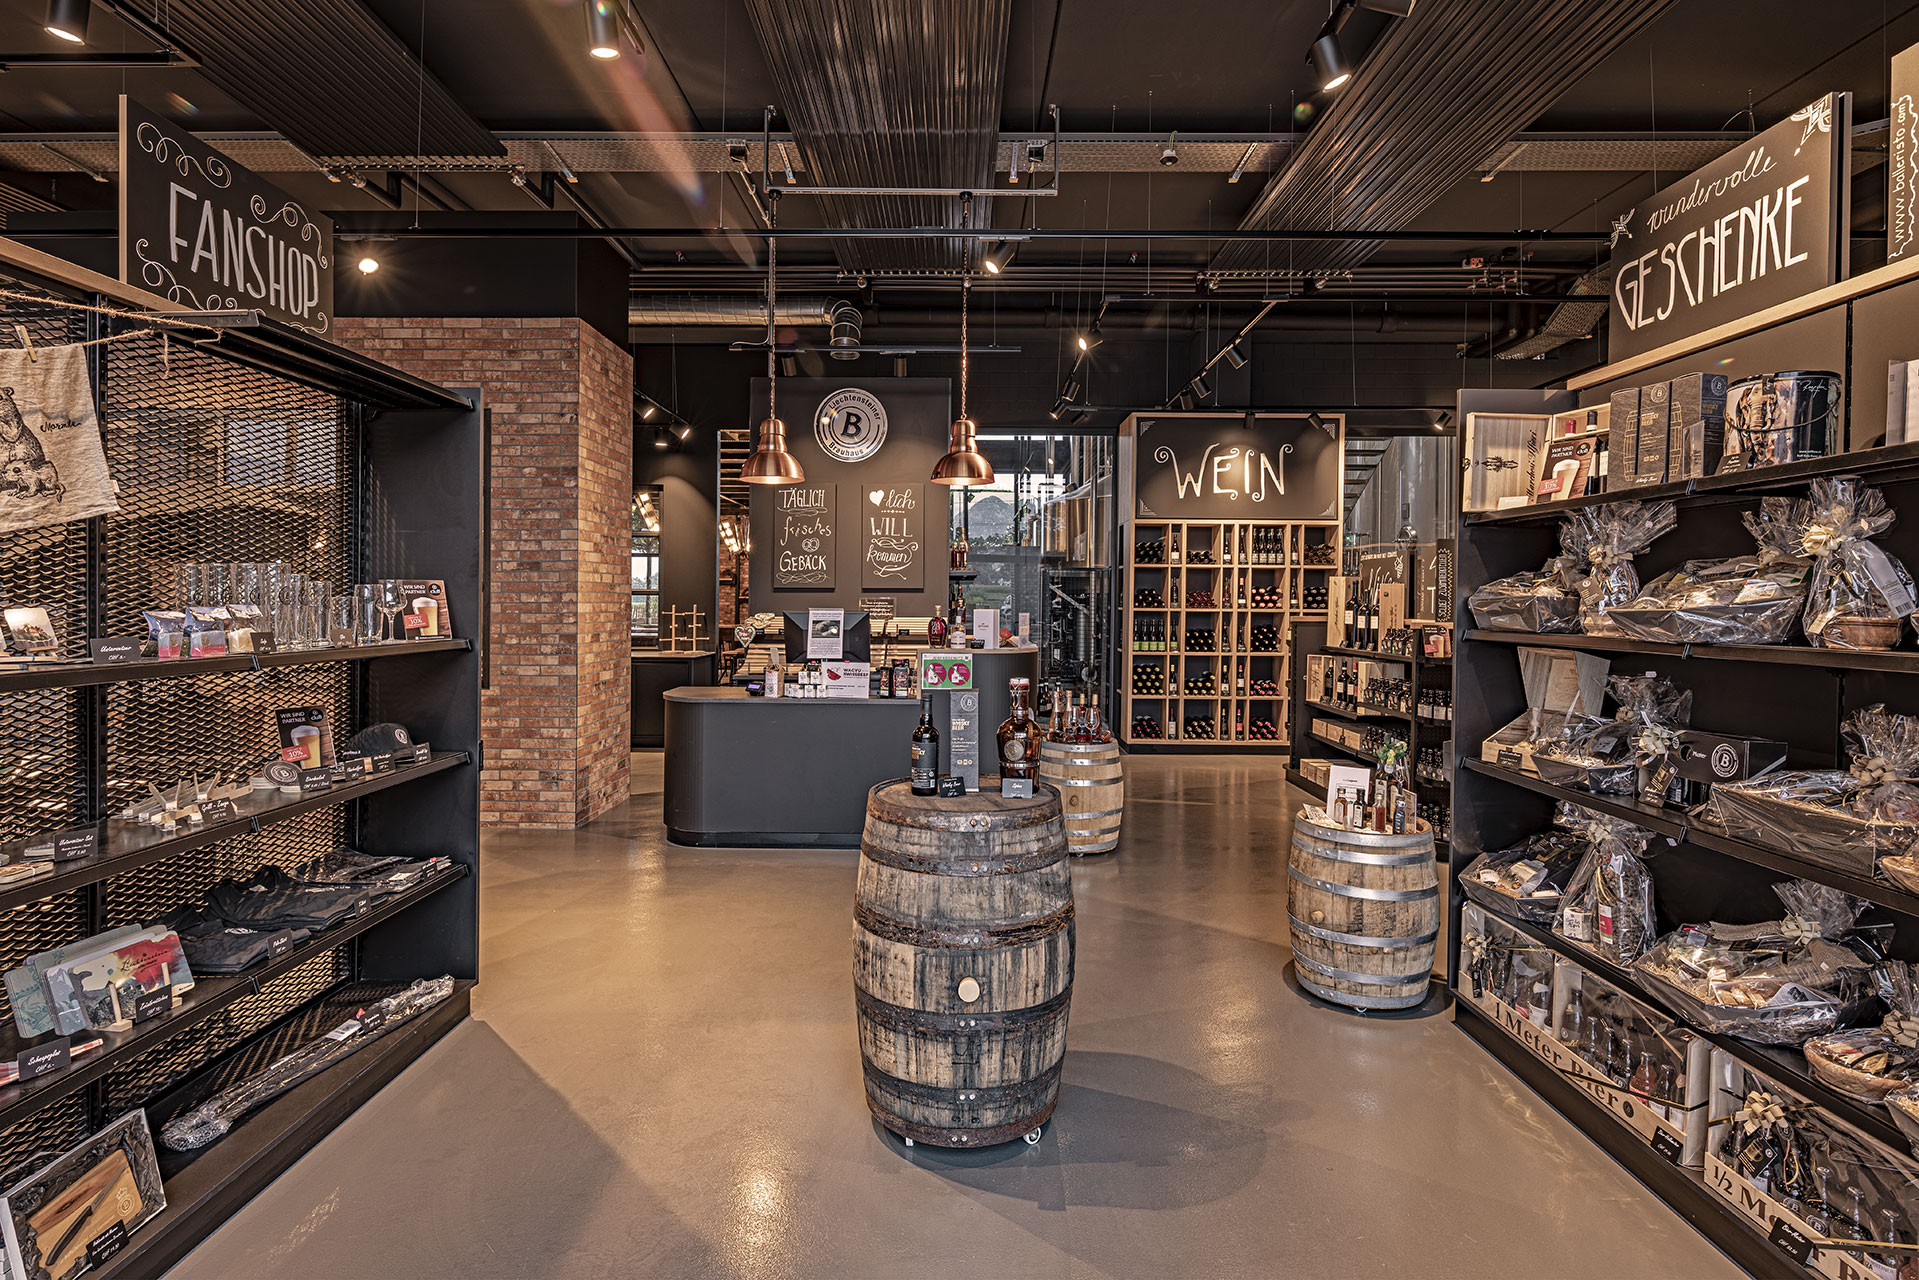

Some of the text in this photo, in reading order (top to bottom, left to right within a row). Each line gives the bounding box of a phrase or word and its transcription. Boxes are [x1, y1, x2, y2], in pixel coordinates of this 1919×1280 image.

[1892, 102, 1906, 243] www.balleristo.com
[1647, 146, 1778, 234] wundervolle
[169, 181, 319, 318] FANSHOP
[1614, 175, 1809, 331] GESCHENKE
[828, 394, 881, 420] Liechtensteiner
[840, 411, 862, 439] B
[828, 441, 864, 457] Brauhaus
[1153, 442, 1294, 503] WEIN
[1526, 461, 1536, 502] Marchesi
[778, 488, 826, 508] TÄGLICH
[780, 516, 832, 546] frisches
[870, 517, 913, 537] WILL
[779, 550, 827, 572] GEBÄCK
[866, 544, 909, 564] kommen
[1719, 753, 1730, 767] B
[1495, 1002, 1619, 1108] 1 Meter Bier
[1713, 1165, 1733, 1195] 1/2
[1813, 1223, 1821, 1231] B
